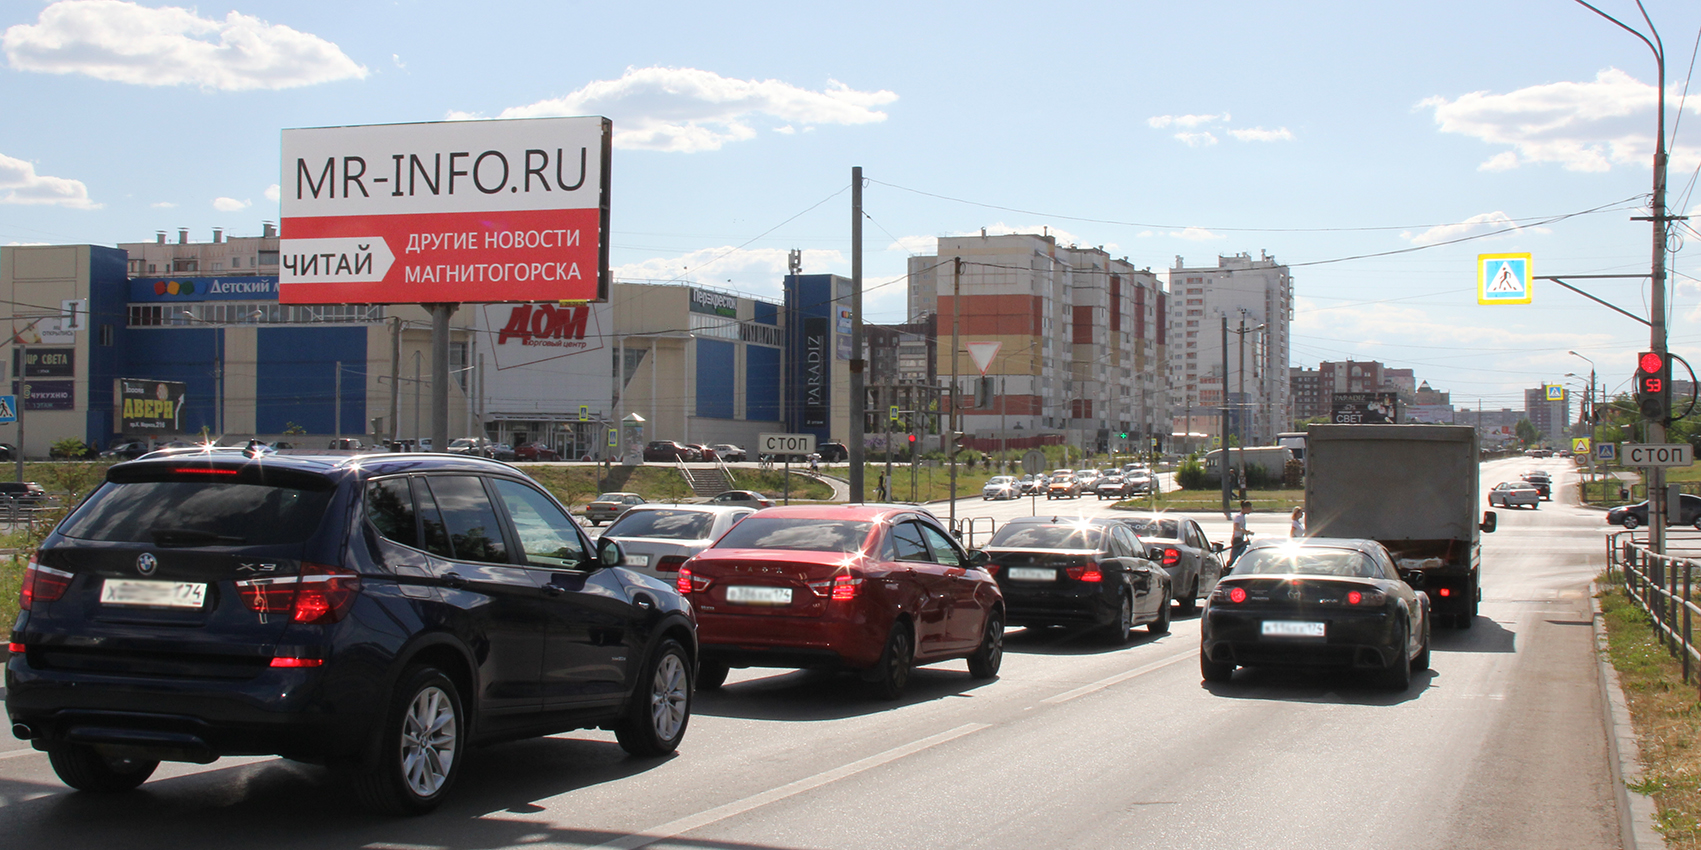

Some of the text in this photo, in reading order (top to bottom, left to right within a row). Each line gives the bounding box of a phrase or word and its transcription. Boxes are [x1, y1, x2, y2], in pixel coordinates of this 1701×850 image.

[297, 147, 587, 199] MR-INFO.RU
[405, 229, 581, 253] ДРУГИЕ НОВОСТИ
[282, 244, 373, 276] ЧИТАЙ
[404, 262, 582, 283] МАГНИТОГОРСКА
[210, 279, 270, 294] Детский
[498, 303, 590, 345] ДОМ
[563, 341, 587, 349] центр
[42, 353, 67, 364] СВЕТА
[807, 335, 821, 406] PARADIZ
[1645, 378, 1661, 392] 53
[1336, 414, 1363, 423] СВЕТ
[767, 437, 807, 450] СТОП
[1631, 448, 1683, 463] СТОП
